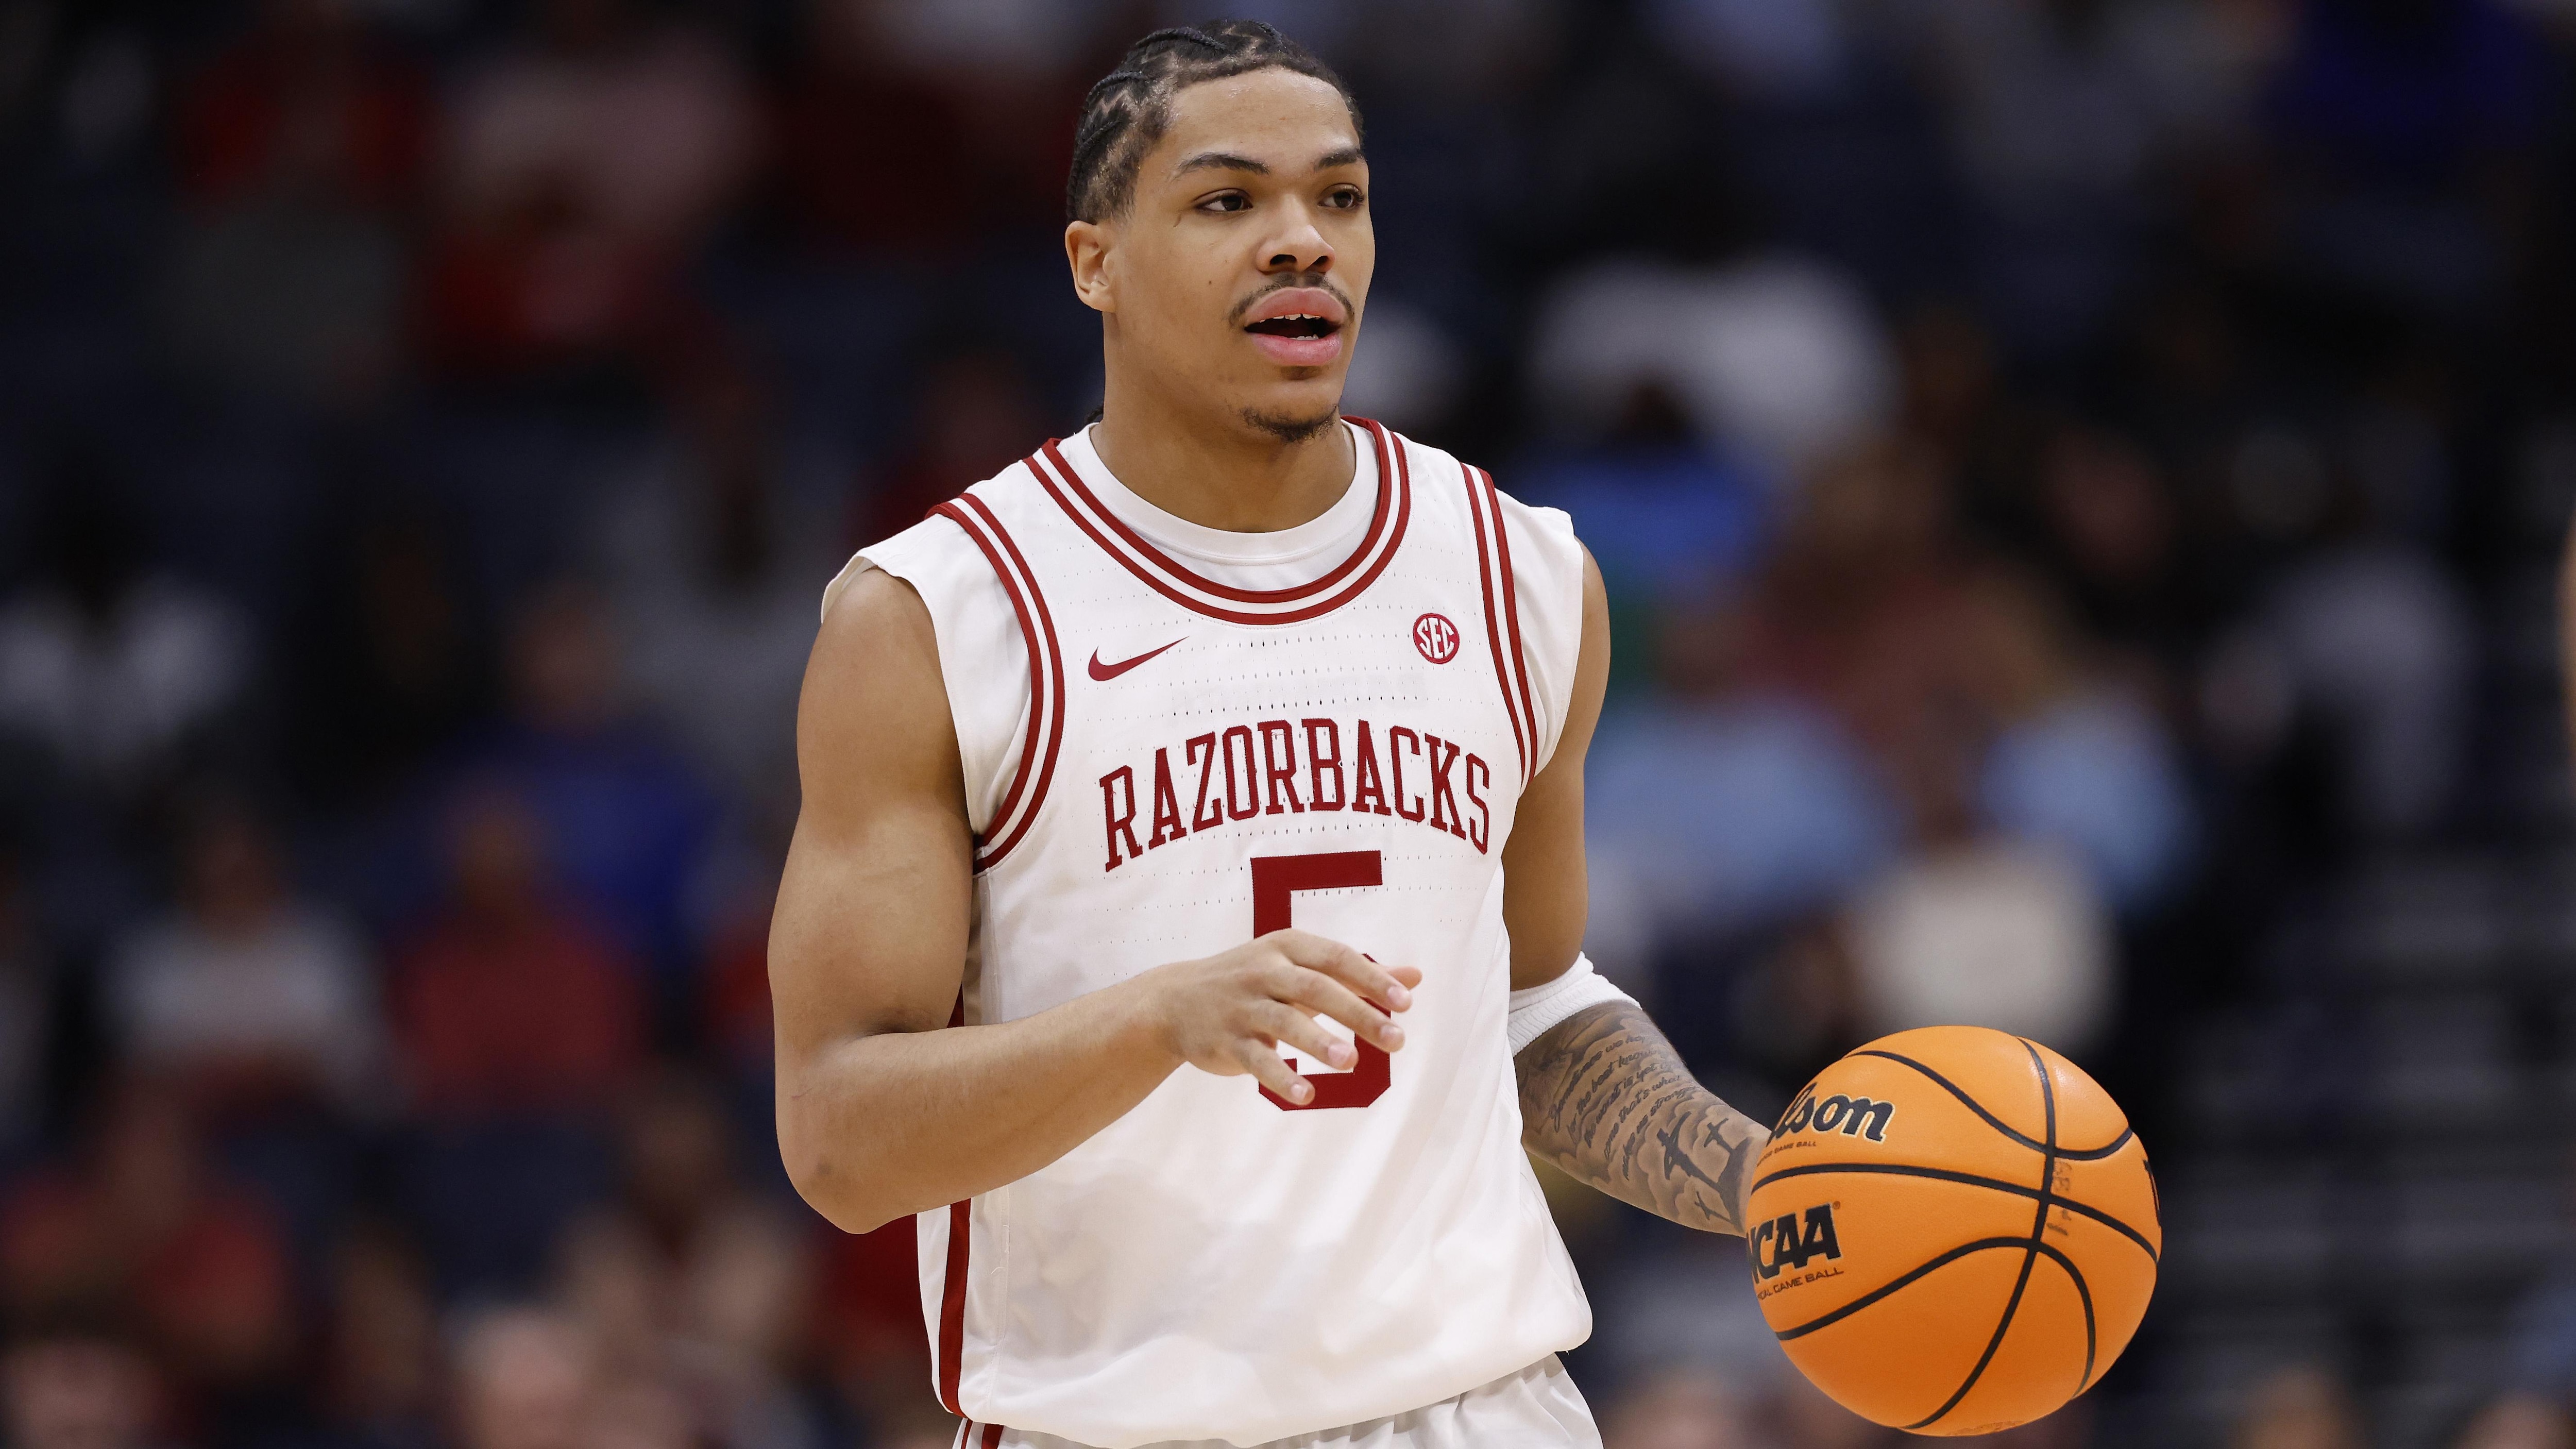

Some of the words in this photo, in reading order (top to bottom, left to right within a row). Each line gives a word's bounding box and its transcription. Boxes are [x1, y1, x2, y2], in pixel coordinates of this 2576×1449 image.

[1417, 617, 1454, 659] SEC
[1099, 718, 1490, 872] RAZORBACKS
[1250, 850, 1391, 1111] 5
[1773, 1277, 1803, 1293] GAME
[1805, 1267, 1844, 1283] BALL
